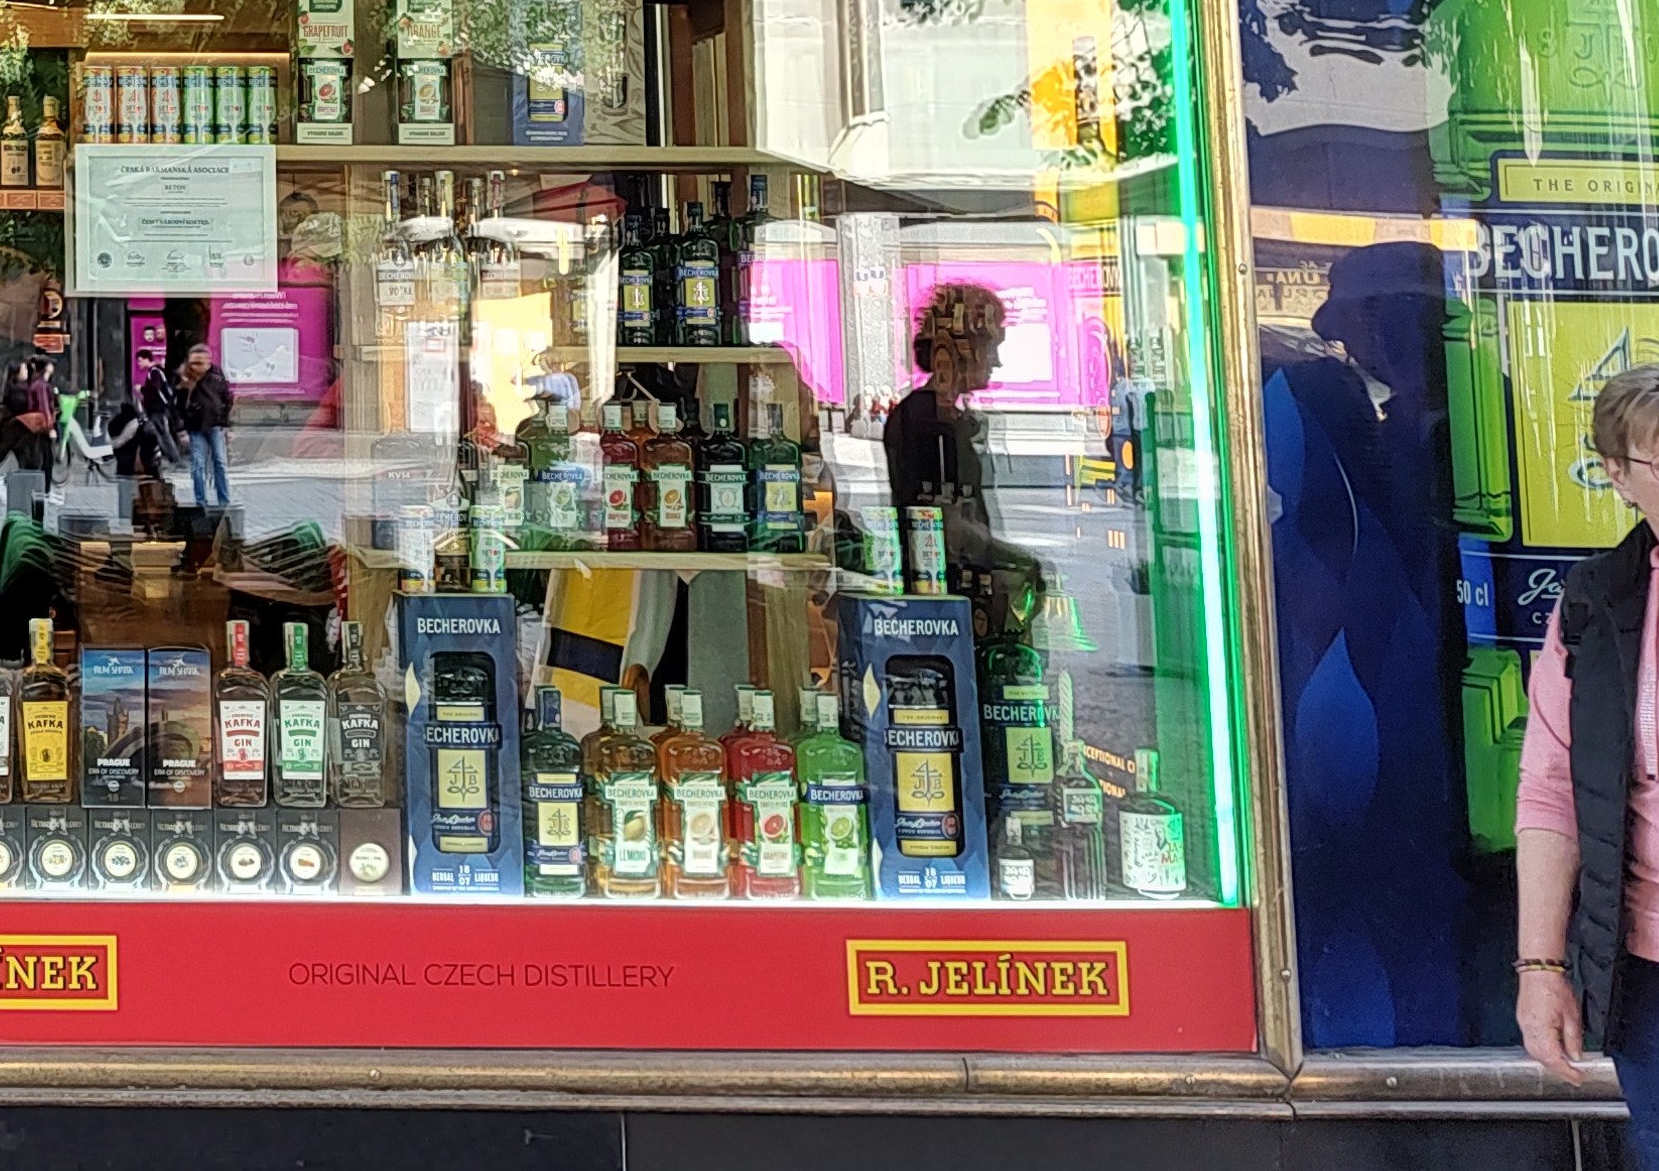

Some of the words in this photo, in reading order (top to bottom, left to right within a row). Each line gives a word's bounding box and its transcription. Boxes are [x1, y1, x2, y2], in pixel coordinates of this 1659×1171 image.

[304, 24, 348, 38] GRAPEFRUIT
[193, 166, 230, 174] ASOCIACE
[1533, 178, 1574, 192] THE
[389, 471, 410, 479] KV14
[1456, 580, 1472, 605] 50
[1475, 582, 1489, 606] cl
[417, 618, 500, 635] BECHEROVKA
[874, 619, 959, 637] BECHEROVKA
[28, 720, 63, 730] KAFKA
[224, 718, 260, 729] KAFKA
[285, 718, 320, 729] KAFKA
[342, 718, 379, 729] KAFKA
[234, 738, 252, 747] GIN
[293, 738, 312, 747] GIN
[351, 738, 370, 747] GIN
[97, 758, 130, 767] PRAGUE
[163, 759, 196, 767] PRAGUE
[529, 786, 582, 798] BECHEROVKA
[608, 788, 655, 799] BECHEROVKA
[676, 788, 723, 799] BECHEROVKA
[749, 788, 795, 799] BECHEROVKA
[810, 788, 863, 800] BECHEROVKA
[288, 962, 416, 986] ORIGINAL
[424, 963, 516, 987] CZECH
[523, 964, 675, 988] DISTILLERY
[865, 961, 909, 995] R.
[919, 953, 1109, 996] JELÍNEK
